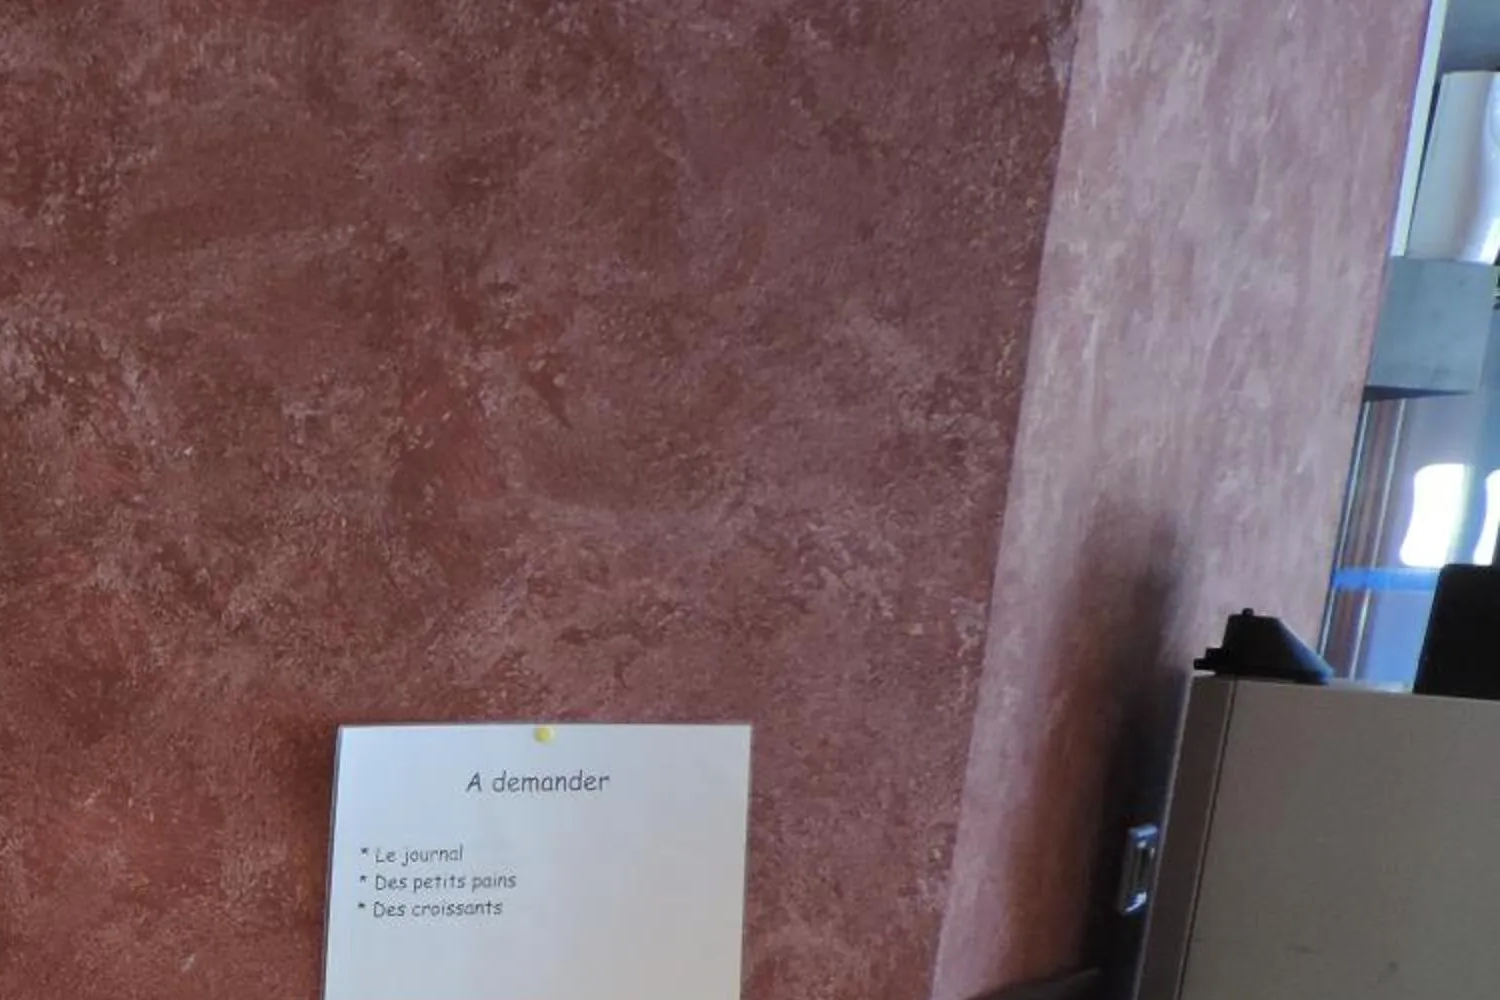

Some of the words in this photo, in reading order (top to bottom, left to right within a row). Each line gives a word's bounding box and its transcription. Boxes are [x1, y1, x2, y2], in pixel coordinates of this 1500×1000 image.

[465, 771, 483, 793] A
[491, 768, 611, 793] demander
[374, 848, 398, 863] Le
[401, 844, 464, 867] journal
[374, 874, 409, 891] Des
[413, 874, 467, 893] petits
[471, 874, 518, 893] pains
[373, 900, 406, 918] Des
[411, 900, 504, 917] croissants
